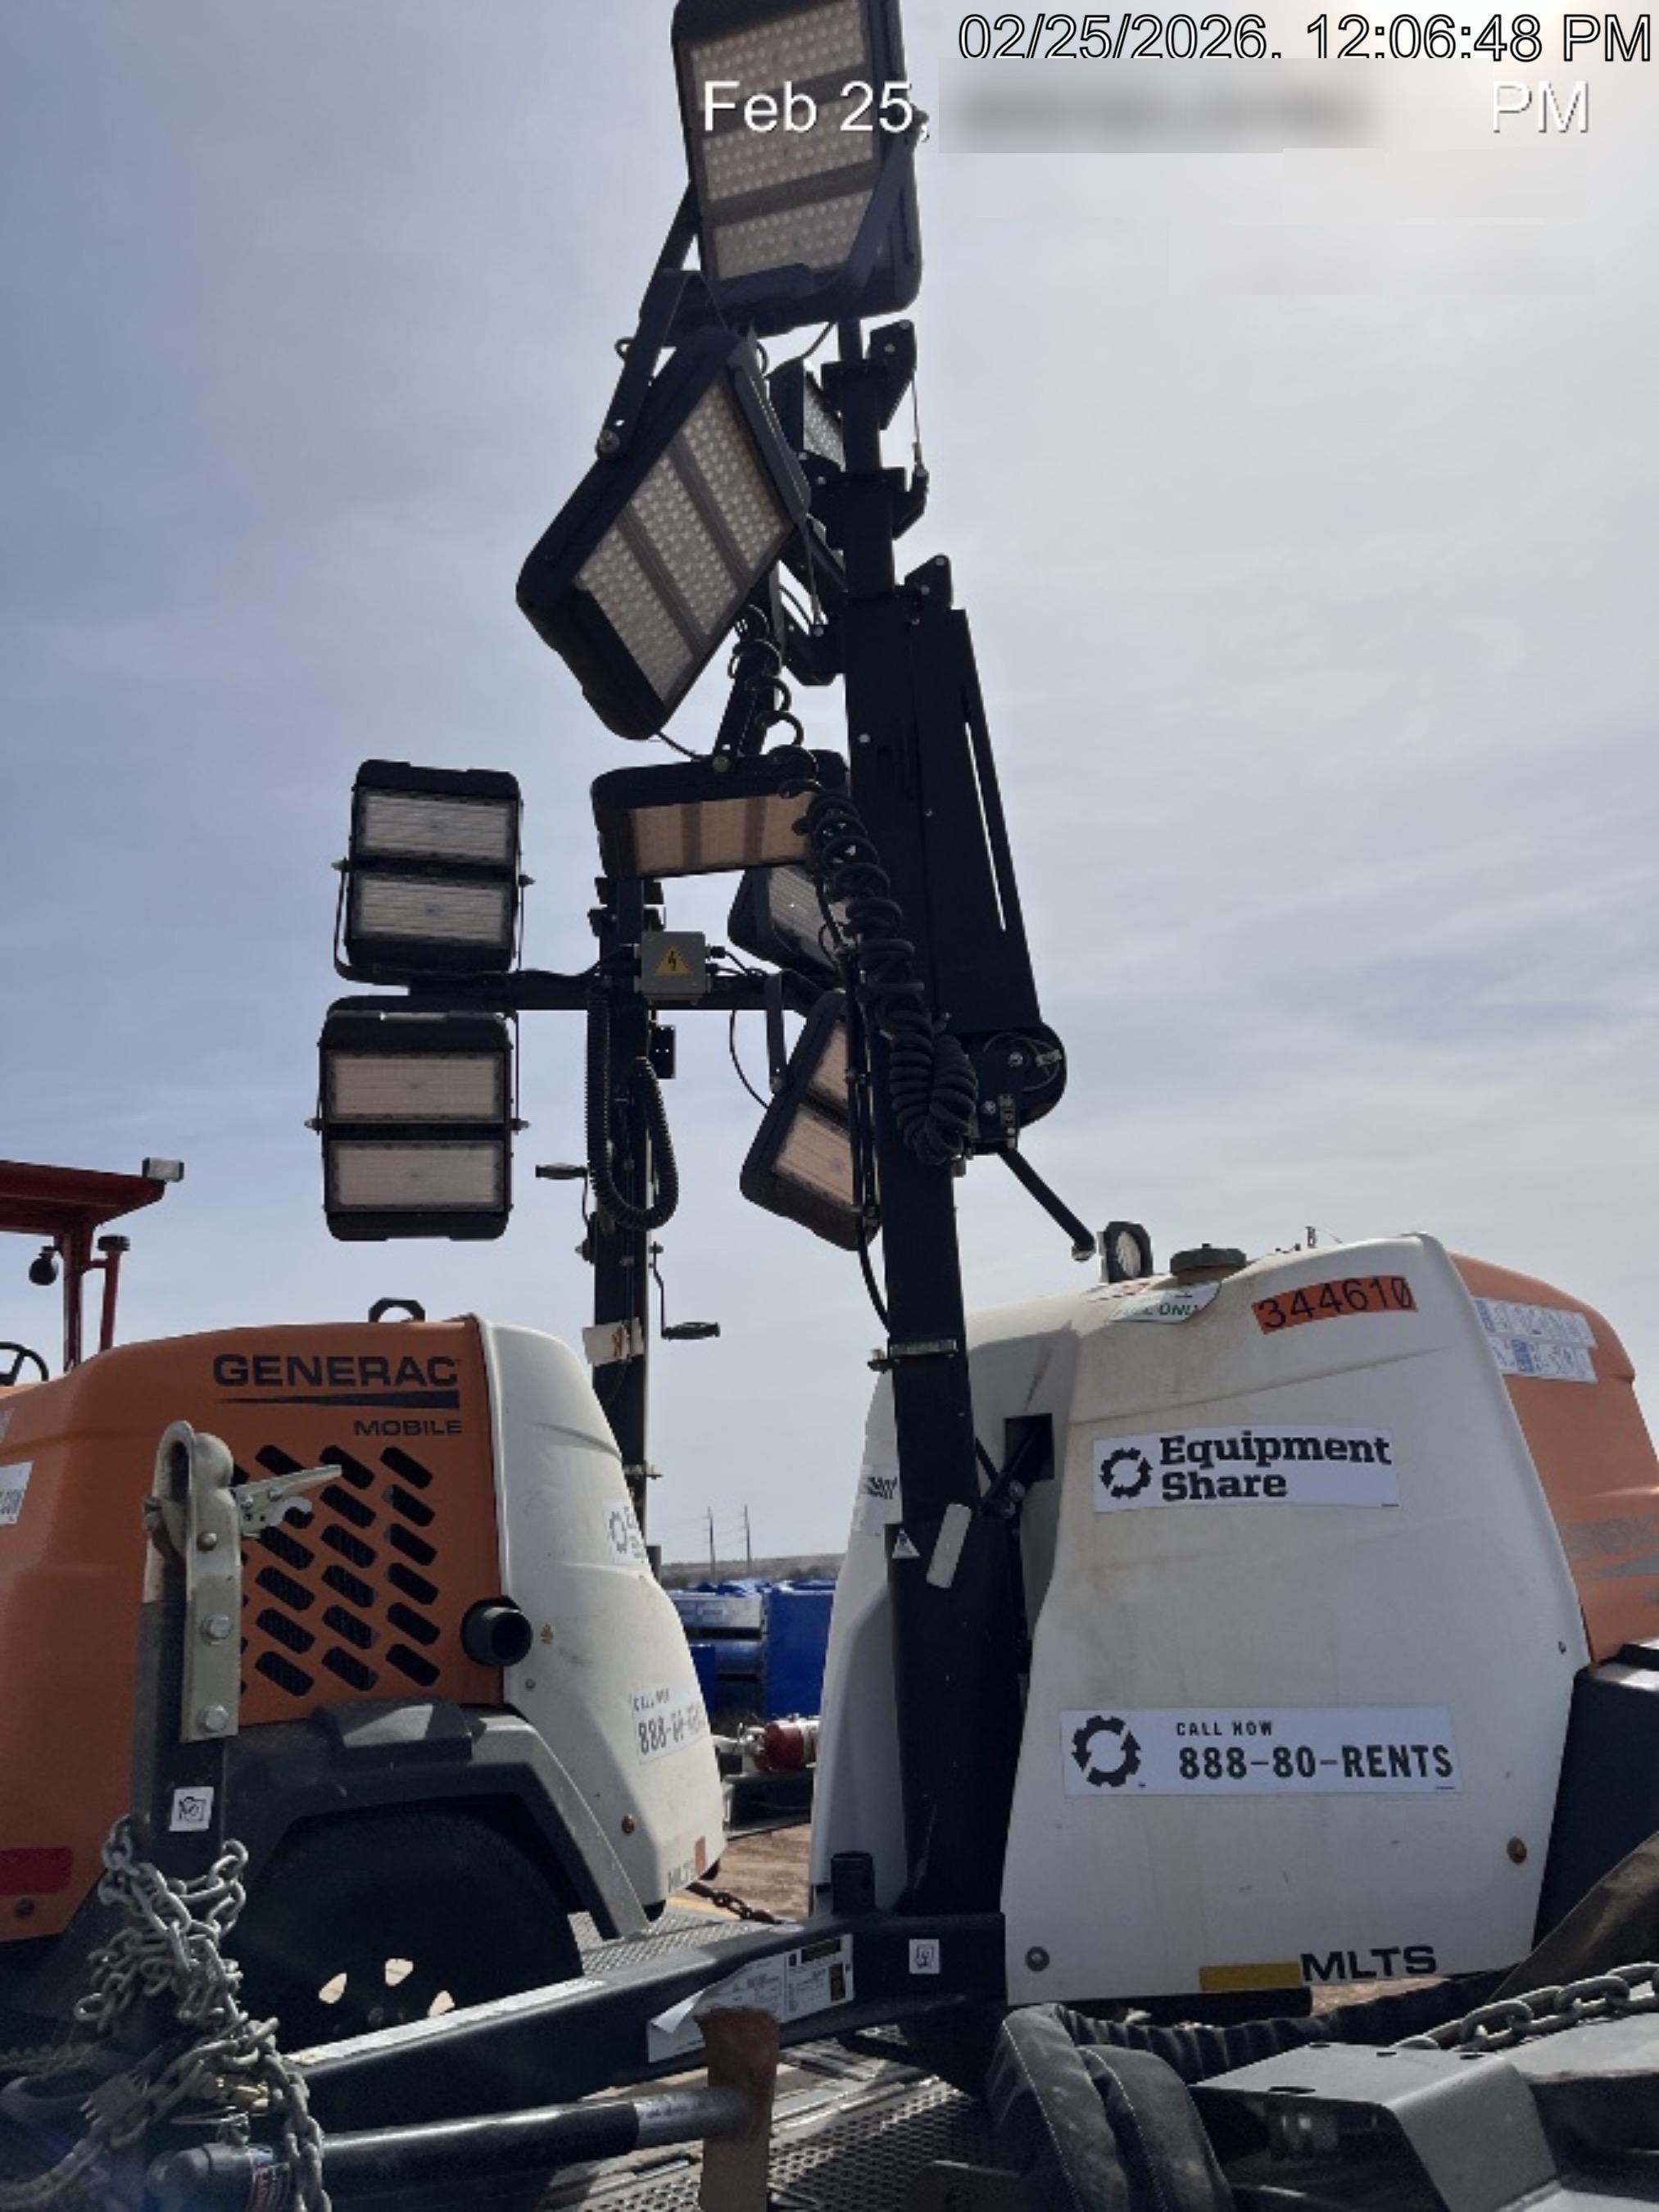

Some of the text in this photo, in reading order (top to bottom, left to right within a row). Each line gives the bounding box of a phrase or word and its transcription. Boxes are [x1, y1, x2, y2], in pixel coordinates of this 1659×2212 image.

[1258, 1276, 1413, 1328] 344610
[213, 1354, 458, 1387] GENERAC
[353, 1420, 462, 1436] MOBILE
[1160, 1430, 1393, 1470] Equipment
[1162, 1471, 1289, 1502] Share
[1176, 1720, 1273, 1736] CALL NOW
[1178, 1743, 1453, 1780] 888-80-RENTS
[1299, 1944, 1438, 1982] MLTS
